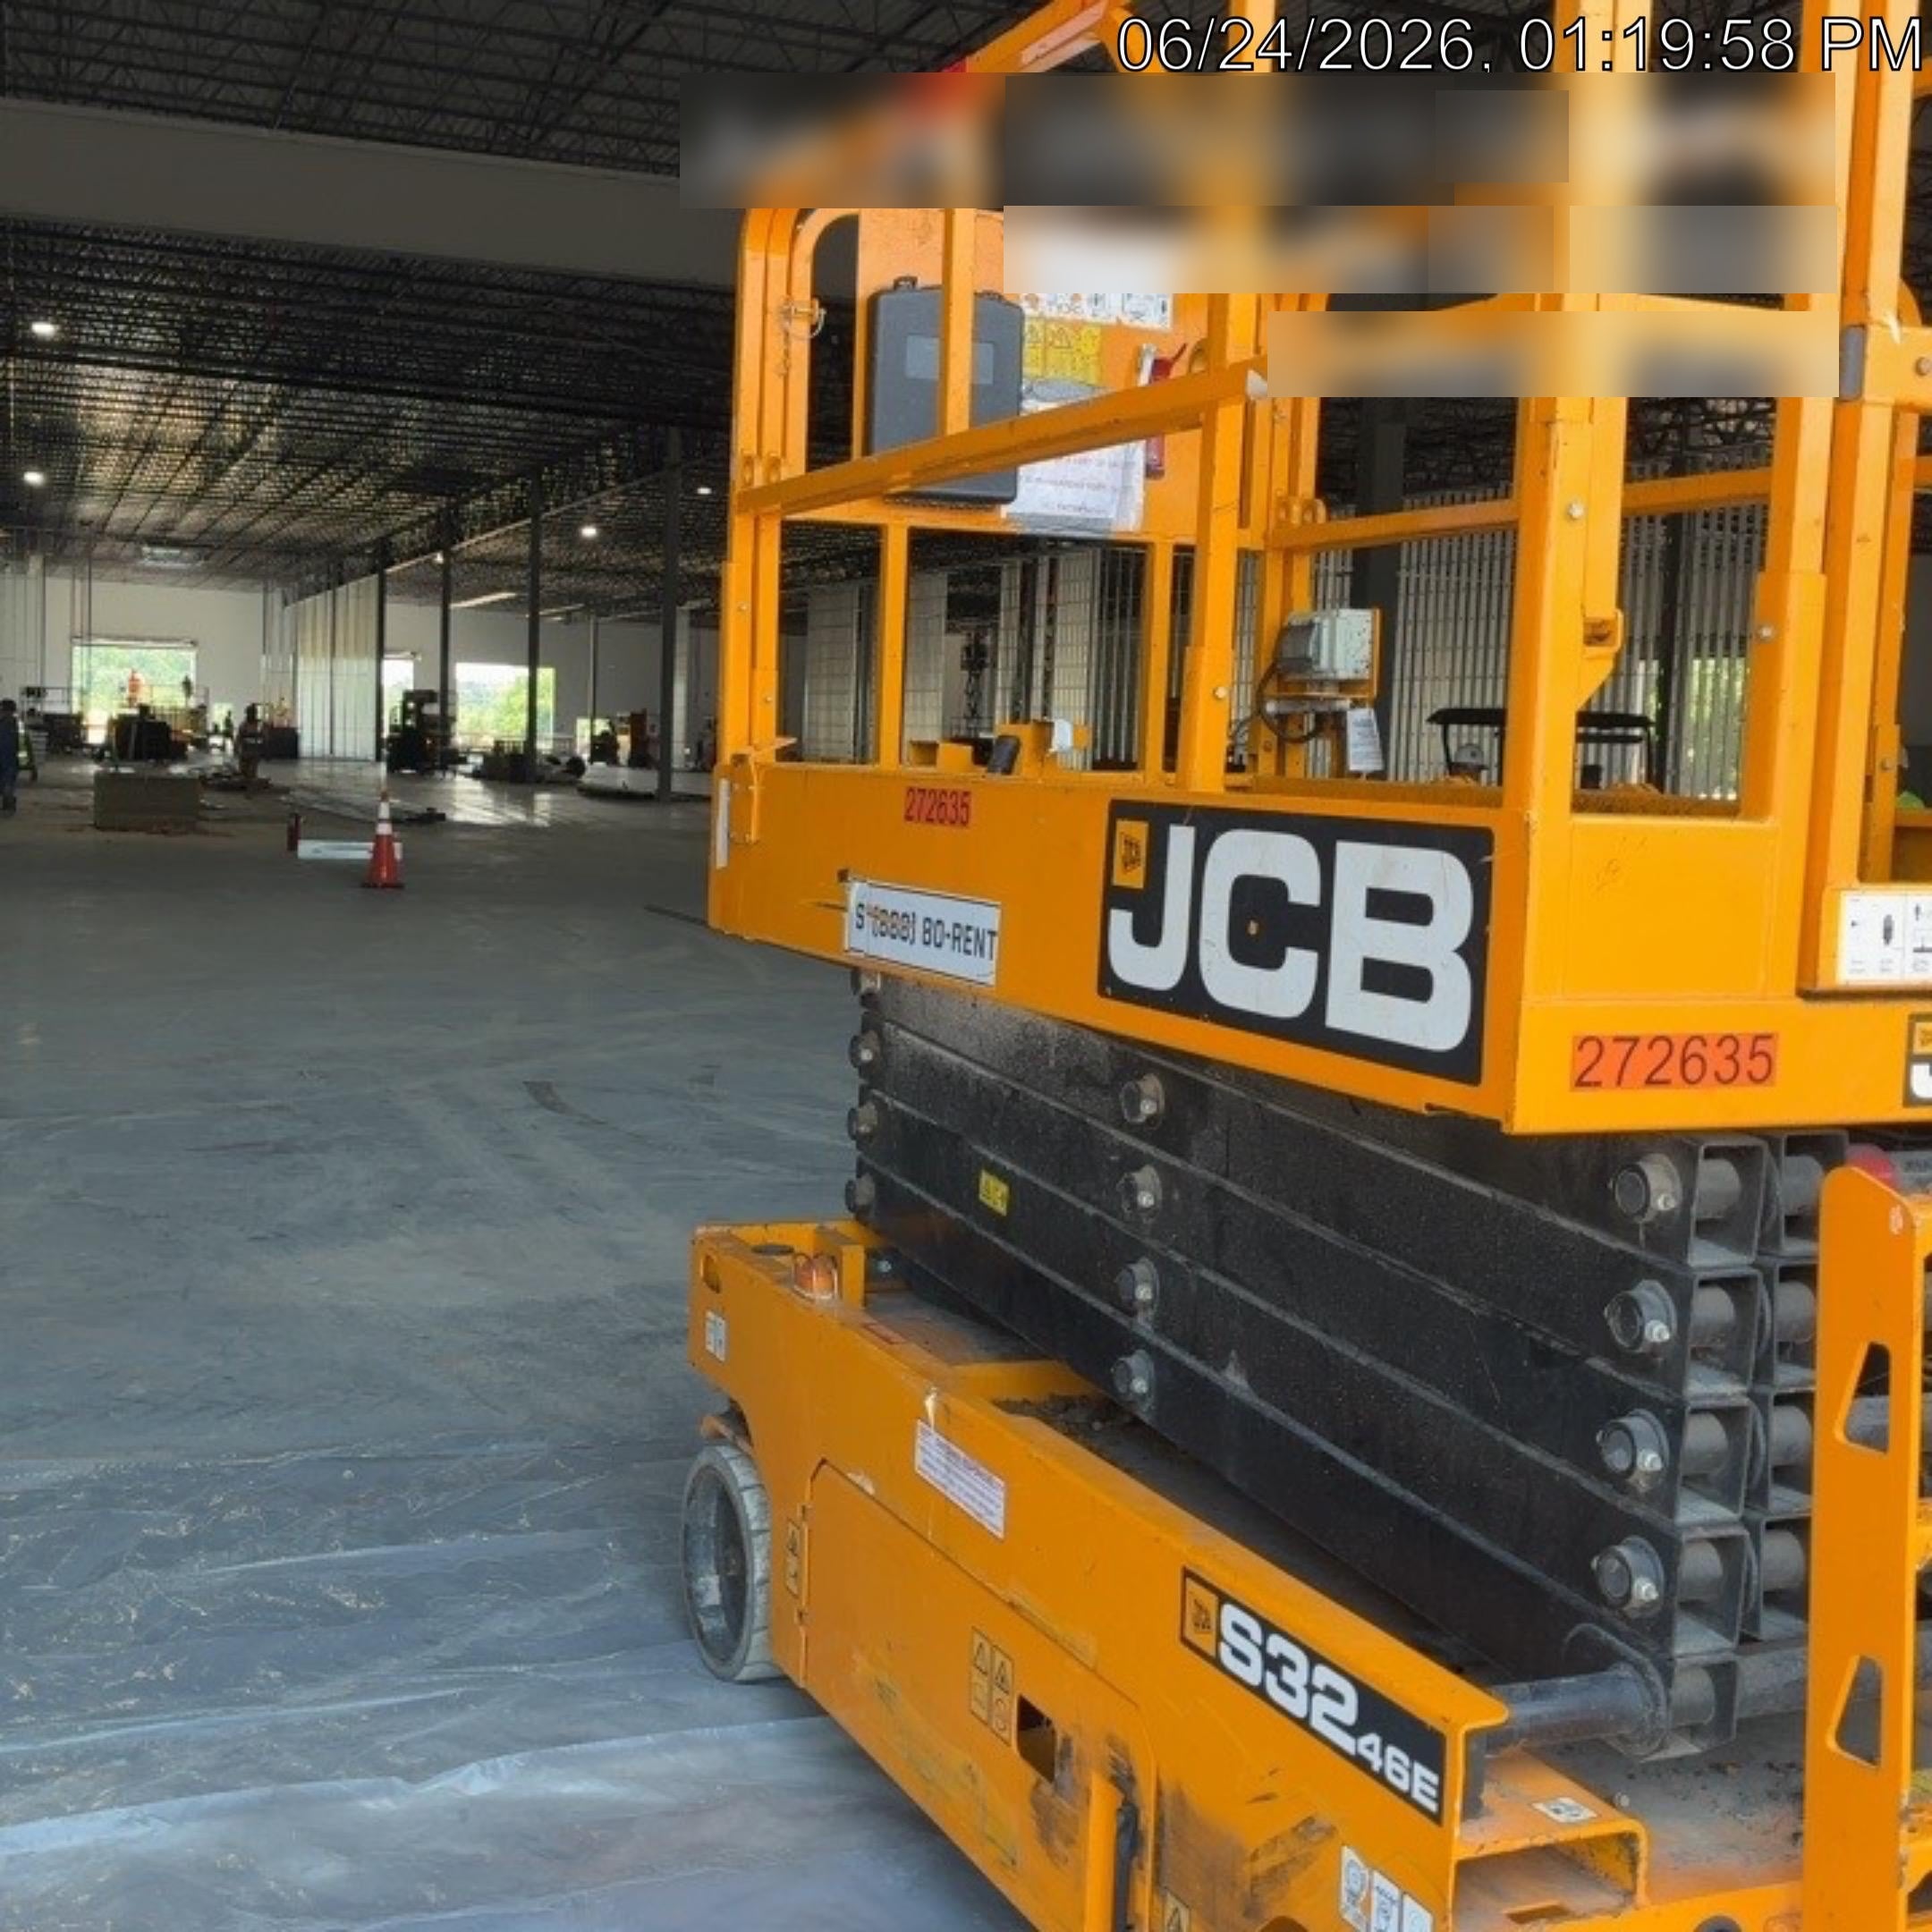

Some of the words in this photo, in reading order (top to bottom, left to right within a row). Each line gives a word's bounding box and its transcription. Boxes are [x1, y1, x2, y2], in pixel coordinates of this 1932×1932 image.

[903, 787, 971, 826] 272635
[1107, 824, 1474, 1052] JCB
[1573, 1035, 1775, 1089] 272635
